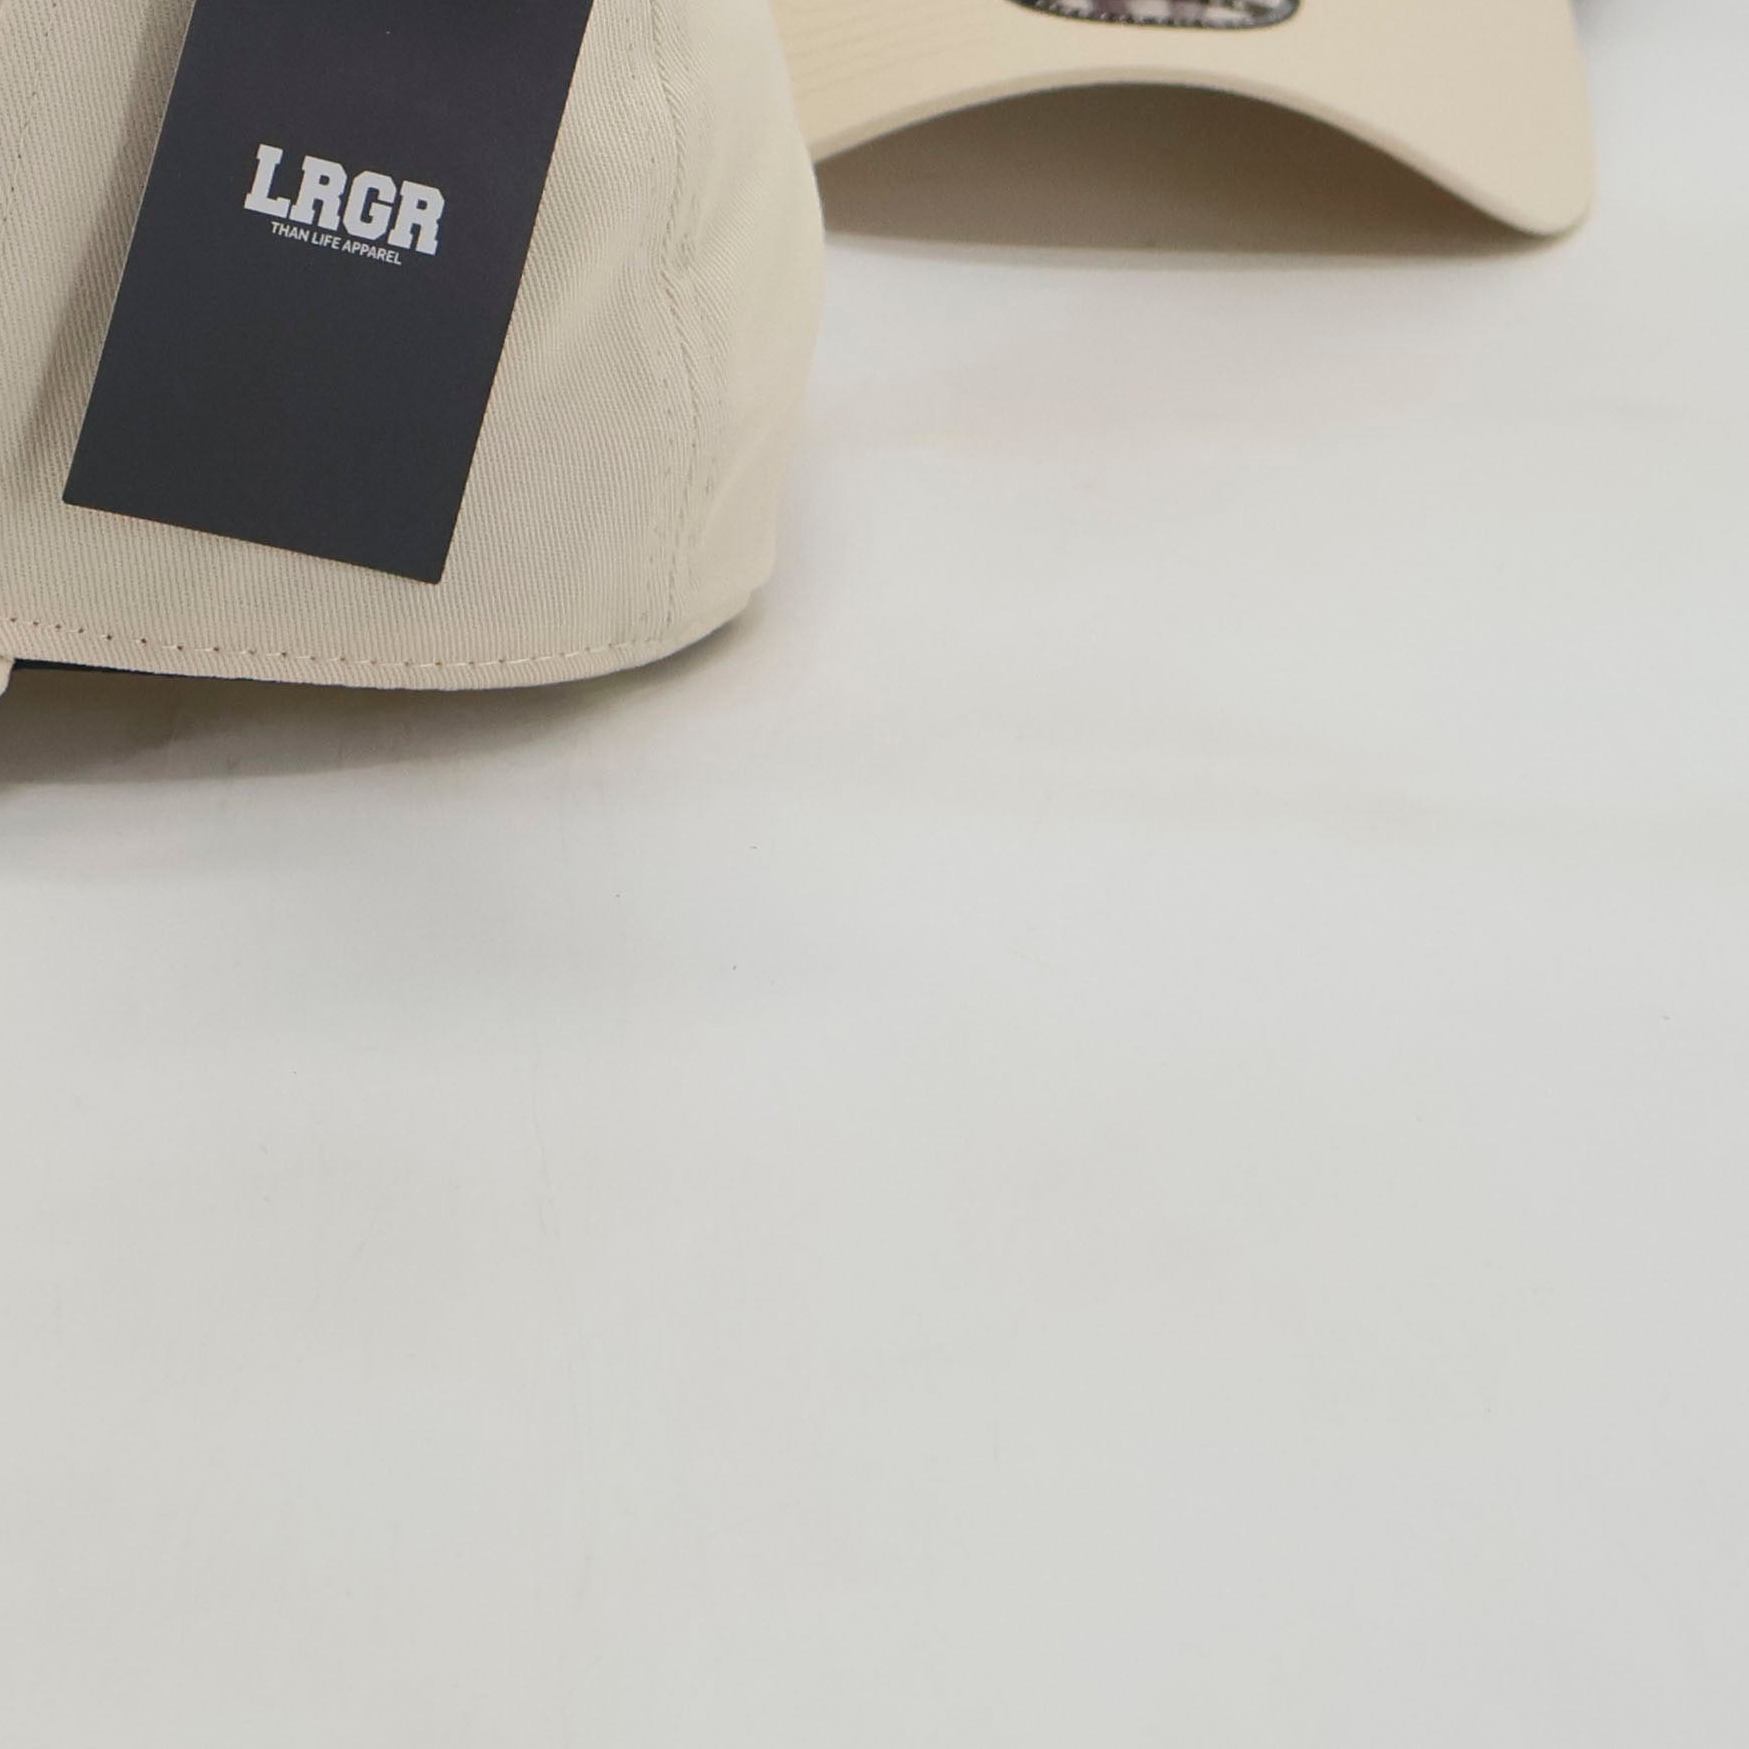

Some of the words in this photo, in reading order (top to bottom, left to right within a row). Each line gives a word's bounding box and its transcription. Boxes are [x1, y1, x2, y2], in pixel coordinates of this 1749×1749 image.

[244, 144, 445, 255] LRGR
[271, 221, 310, 243] THAN
[311, 231, 340, 250] LIFE
[341, 239, 402, 266] APPAREL
